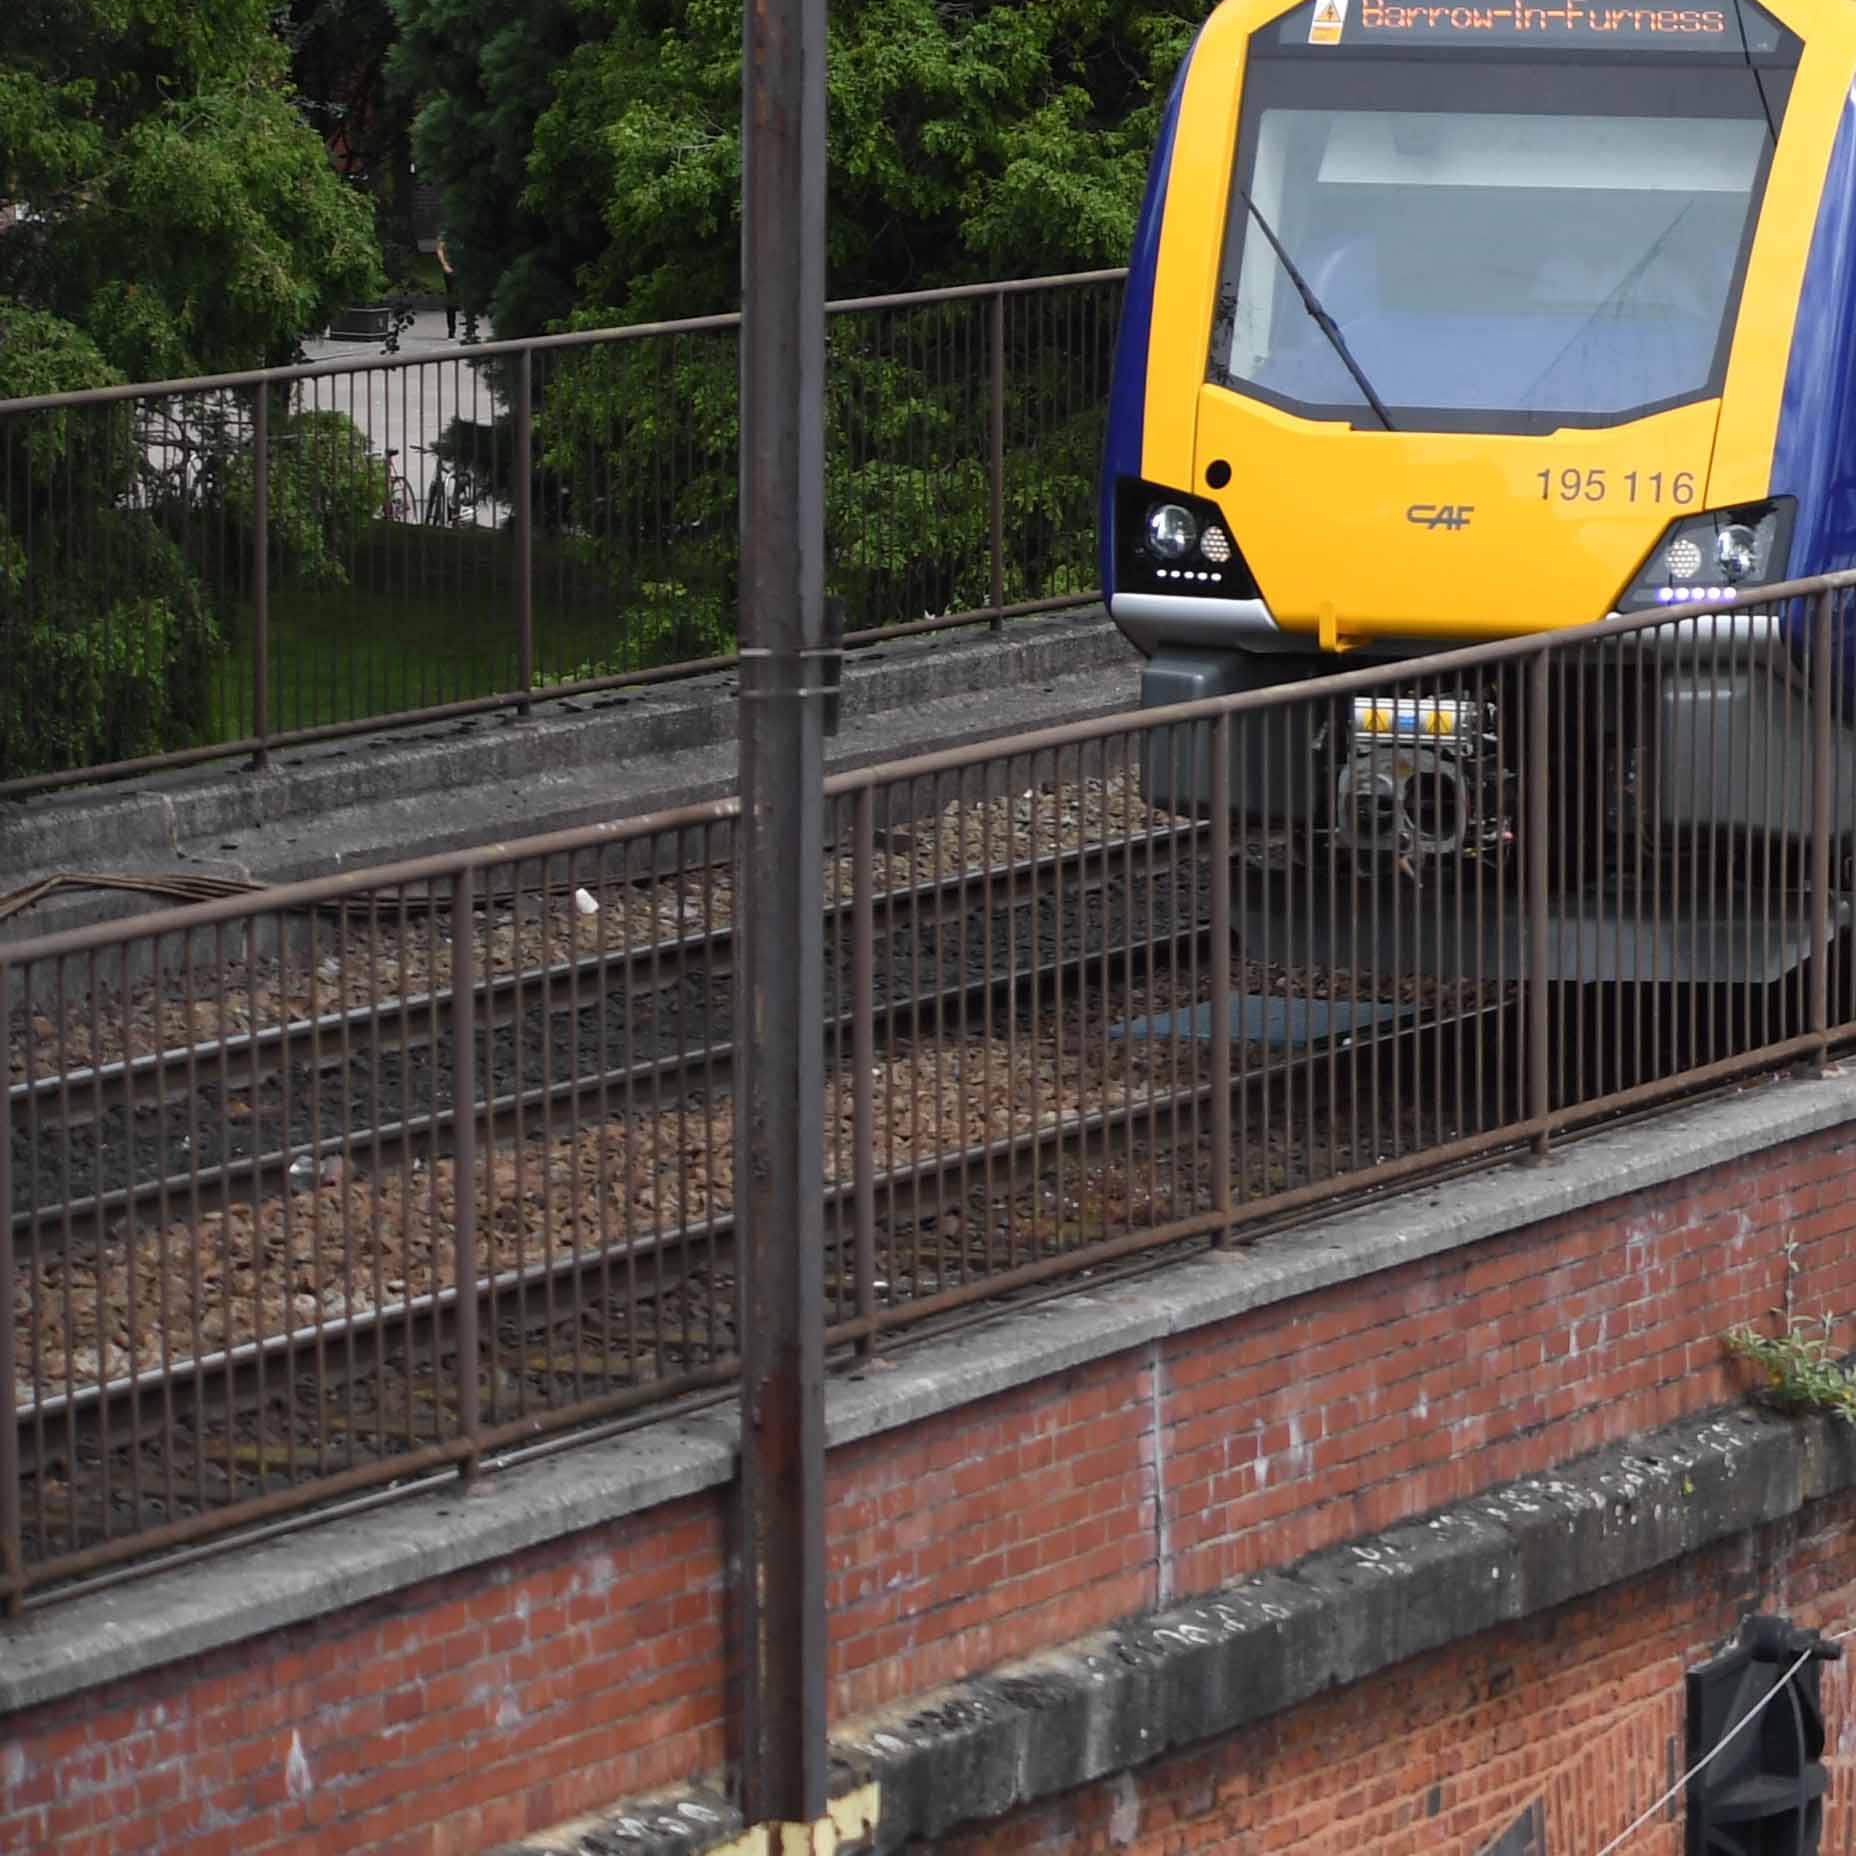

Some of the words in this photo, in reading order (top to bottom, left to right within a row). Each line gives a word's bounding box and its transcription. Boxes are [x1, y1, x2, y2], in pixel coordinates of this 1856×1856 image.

[1537, 467, 1607, 502] 195
[1623, 471, 1696, 505] 116
[1406, 504, 1475, 531] CAF
